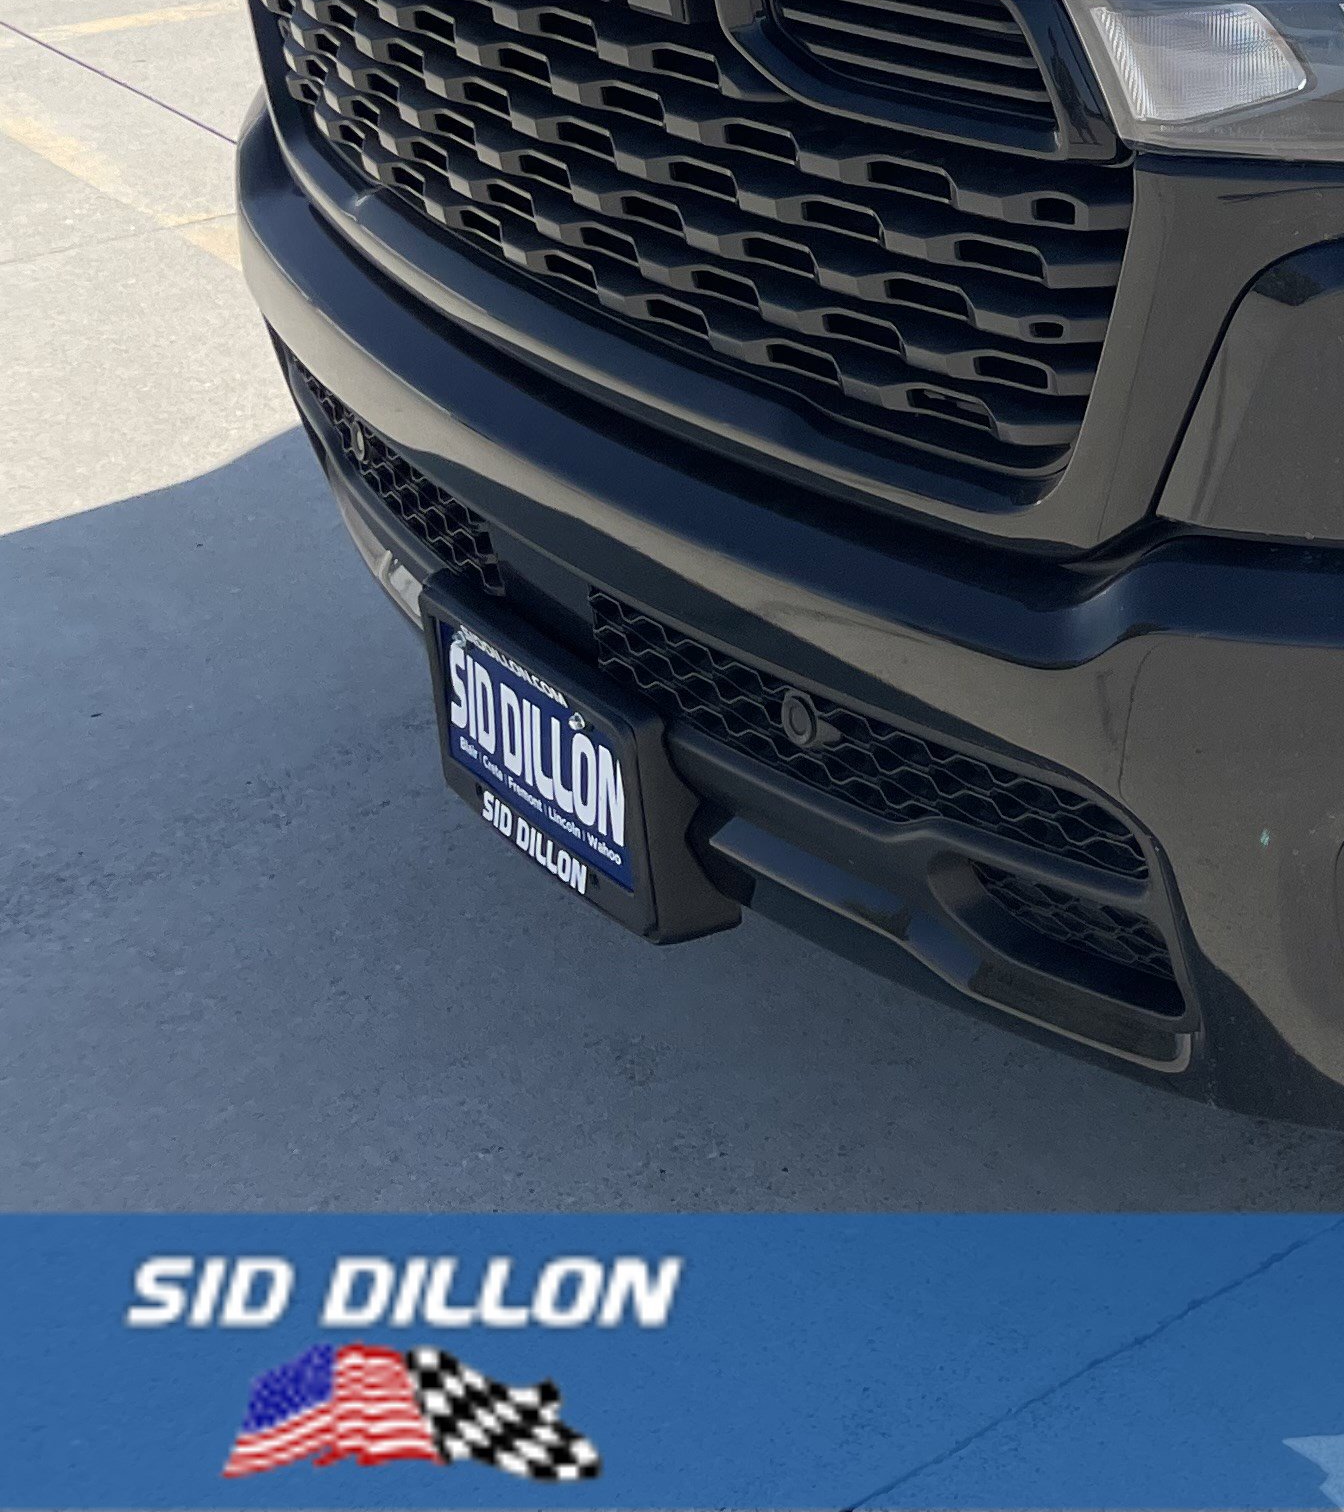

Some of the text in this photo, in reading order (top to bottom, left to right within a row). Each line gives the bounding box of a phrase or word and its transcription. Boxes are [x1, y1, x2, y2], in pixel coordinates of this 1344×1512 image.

[449, 639, 625, 848] SID DILLON
[482, 790, 588, 895] SID DILLON
[508, 775, 544, 813] Fremont
[548, 805, 582, 839] Lincoln
[587, 831, 622, 866] Wahoo
